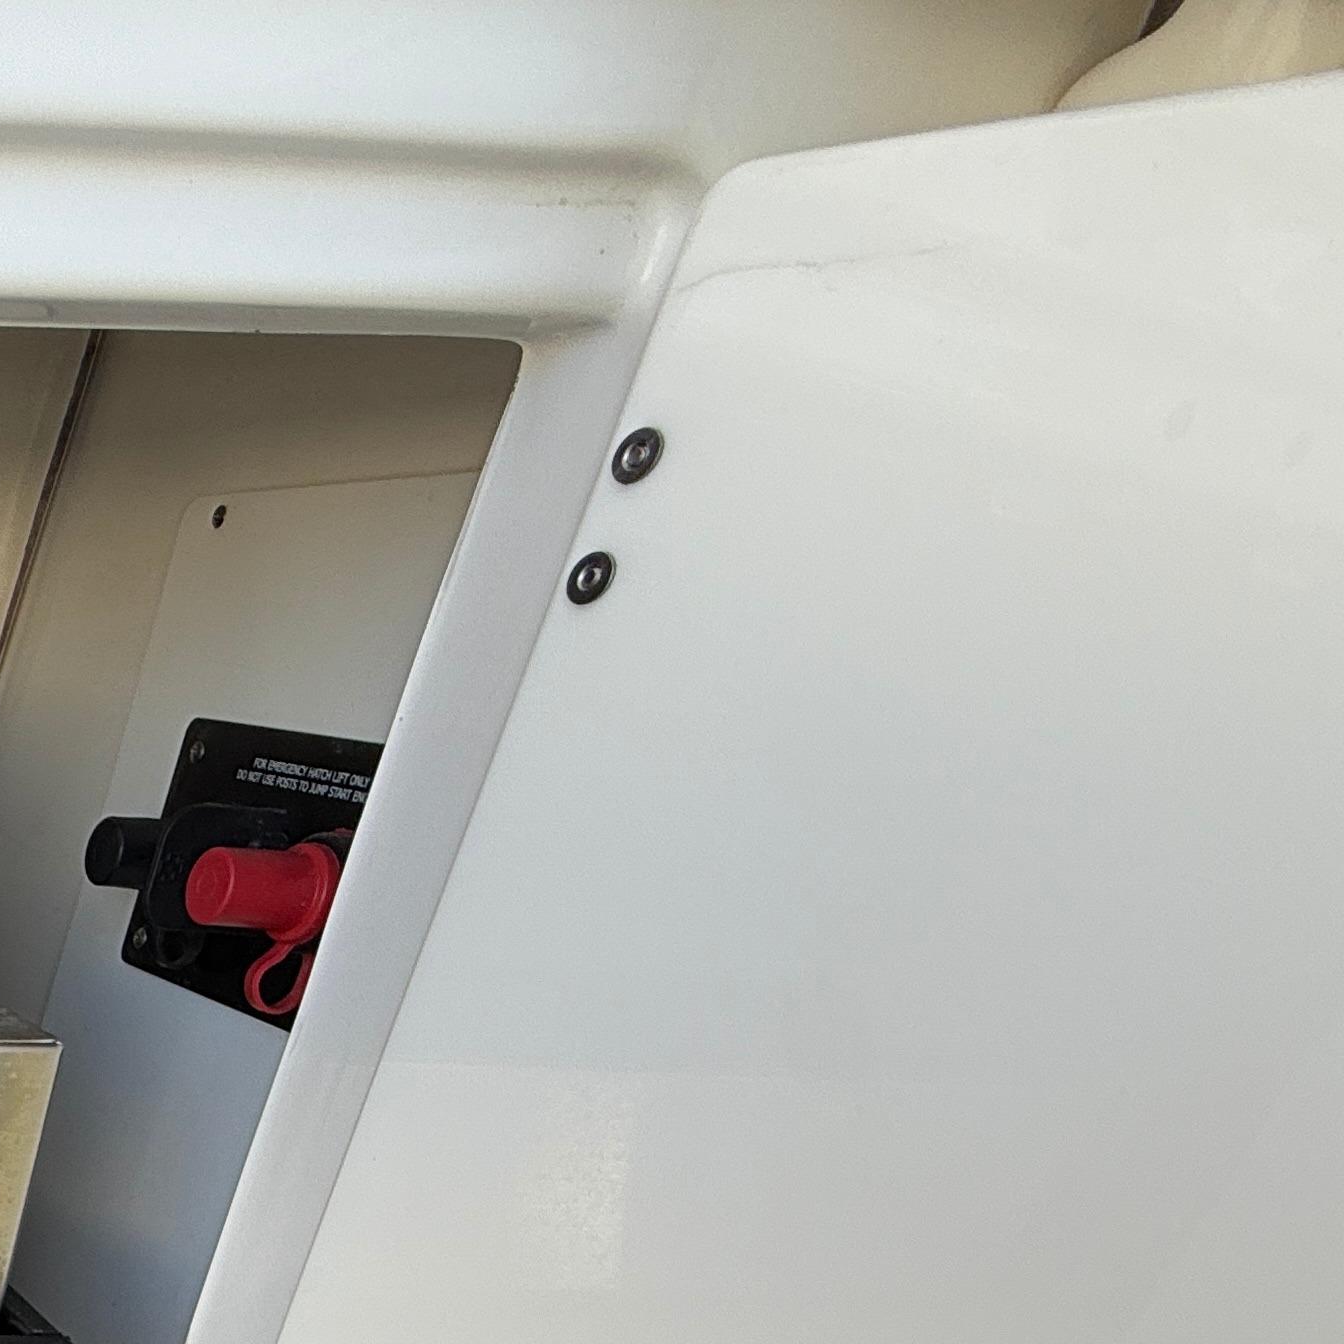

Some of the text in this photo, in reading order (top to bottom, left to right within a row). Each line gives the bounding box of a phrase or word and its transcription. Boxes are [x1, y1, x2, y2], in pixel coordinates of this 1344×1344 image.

[237, 768, 247, 780] DO
[248, 770, 262, 782] NOT
[262, 773, 276, 786] USE
[276, 775, 298, 790] POSTS
[299, 779, 309, 792] TO
[309, 782, 328, 795] JUMP
[328, 785, 352, 800] START
[253, 757, 370, 787] FOR EMERGENCY HATCH LIFT ONLY
